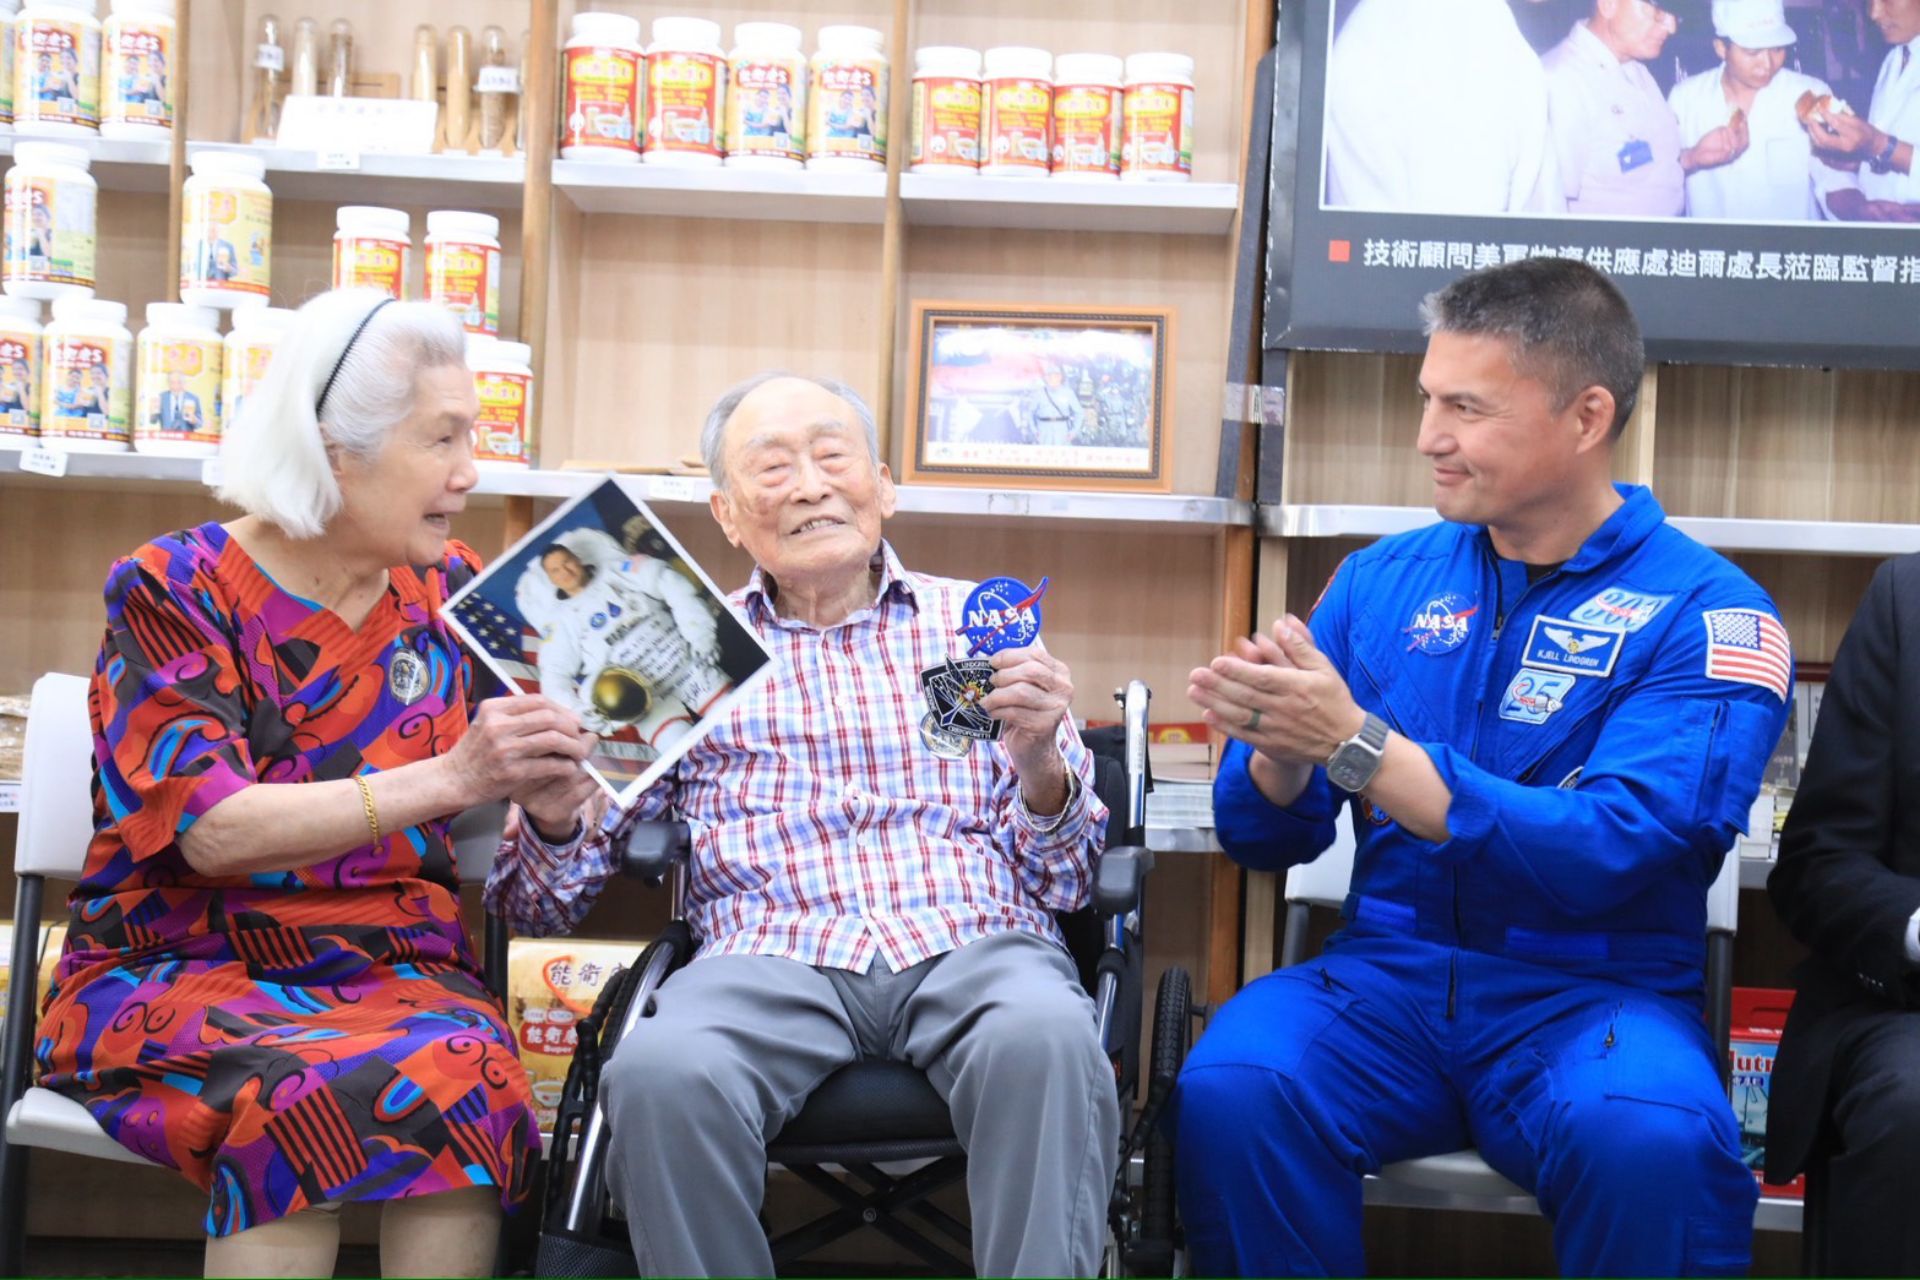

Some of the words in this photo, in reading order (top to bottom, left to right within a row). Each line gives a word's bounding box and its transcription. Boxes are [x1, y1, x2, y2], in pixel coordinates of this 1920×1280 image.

[968, 608, 1037, 628] NASA
[1413, 613, 1469, 633] NASA
[1537, 649, 1559, 661] KJELL
[1563, 653, 1600, 667] LINDGREN
[550, 962, 624, 987] 能衛
